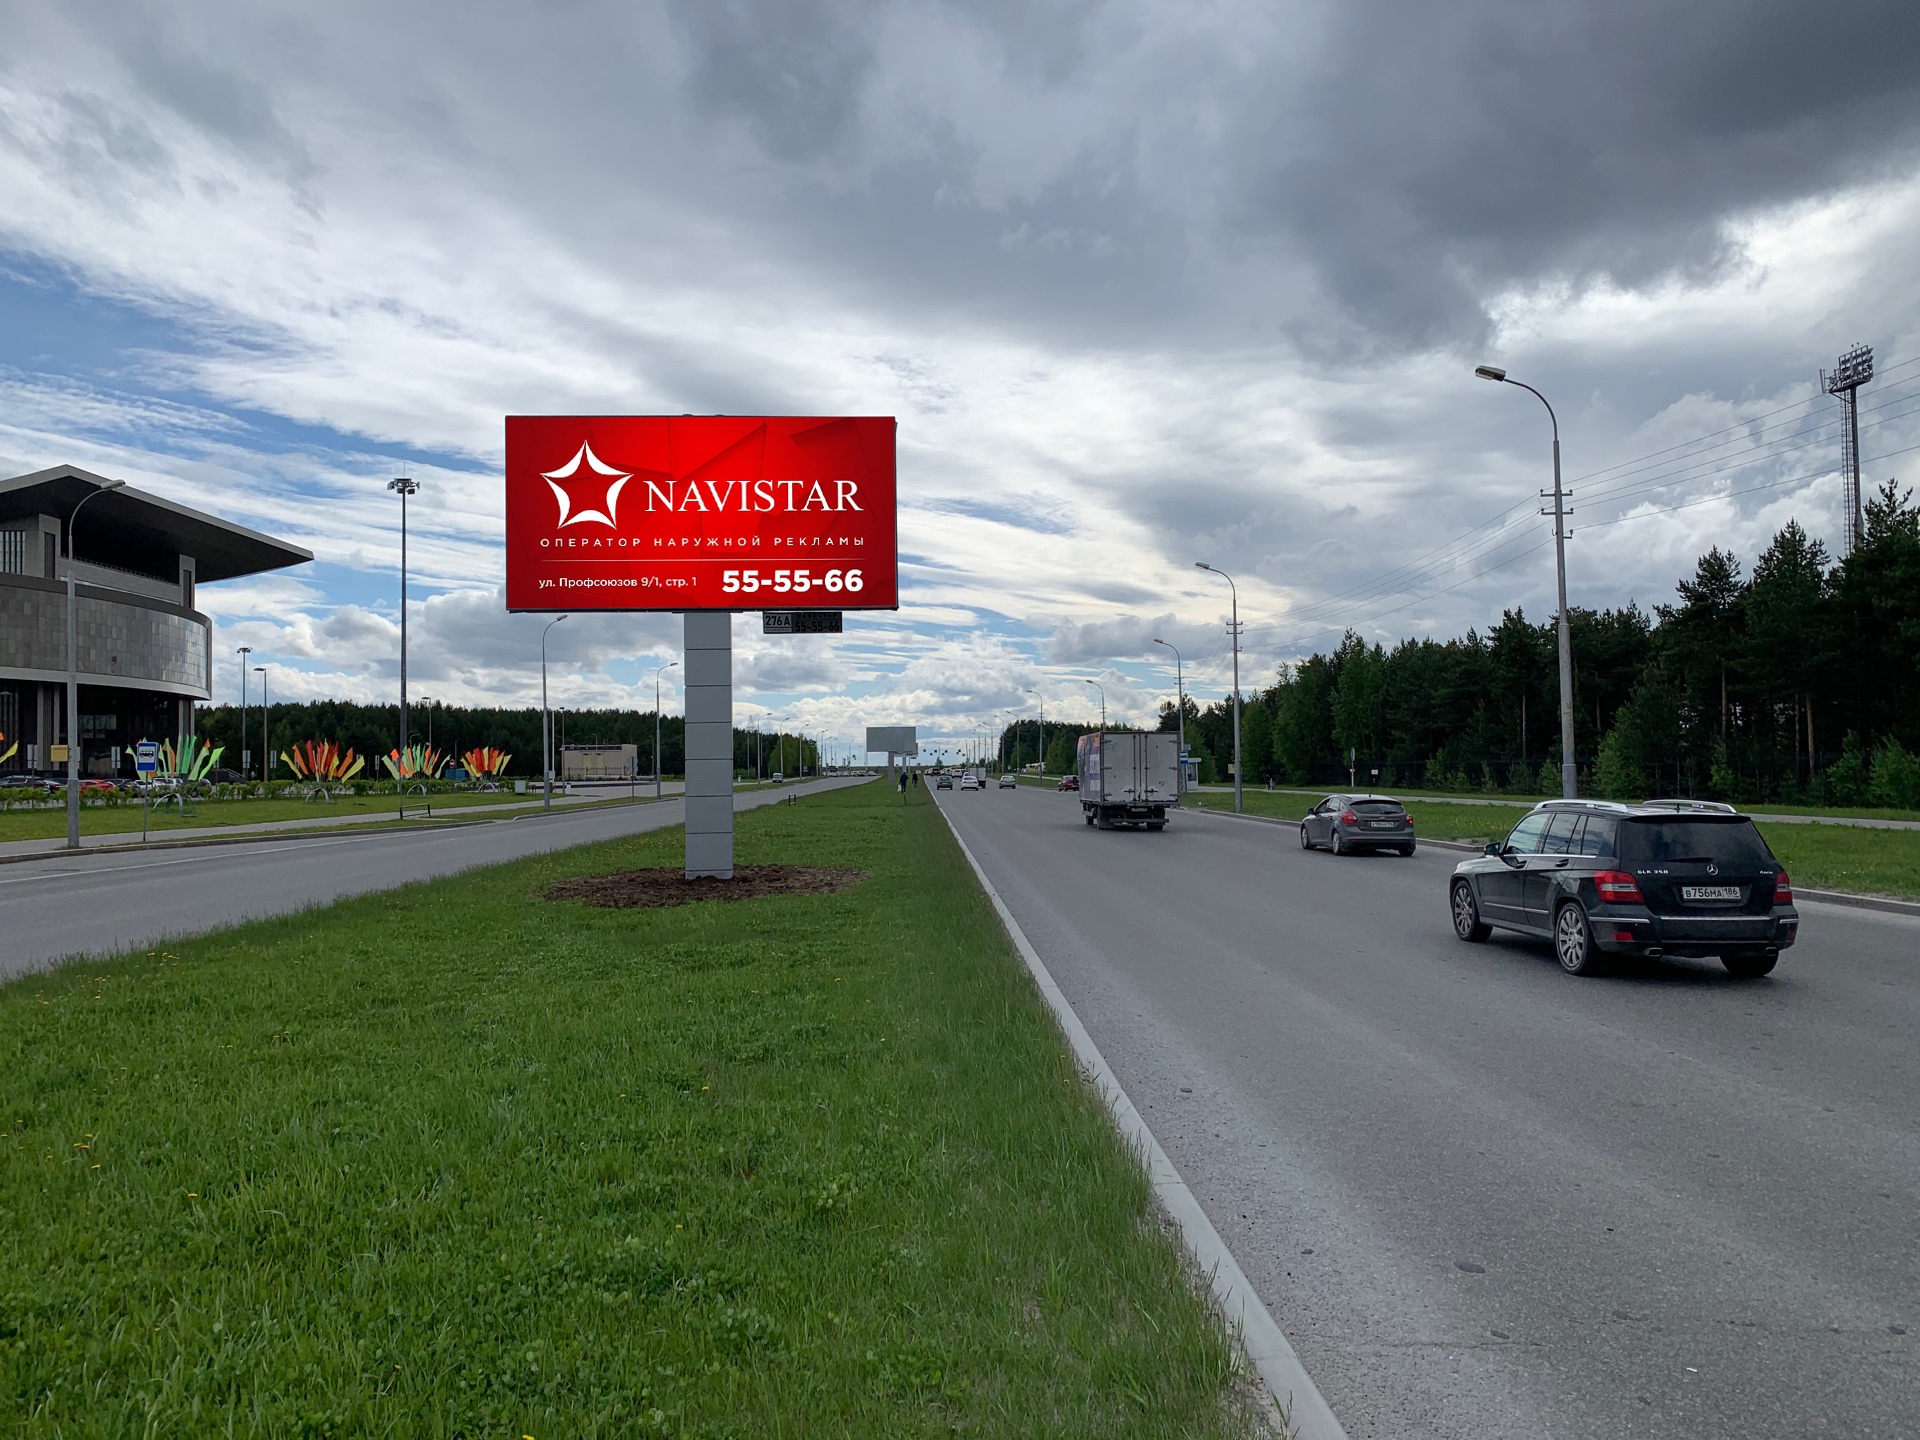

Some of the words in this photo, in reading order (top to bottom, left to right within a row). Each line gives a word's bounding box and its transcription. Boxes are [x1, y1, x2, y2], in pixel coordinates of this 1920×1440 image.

[643, 479, 864, 512] NAVISTAR
[540, 537, 641, 548] ОПЕРАТОР
[653, 534, 761, 547] НАРУЖНОЙ
[773, 536, 865, 547] РЕКЛАМЫ
[538, 579, 556, 588] ул.
[559, 577, 638, 589] Профсоюзов
[641, 576, 663, 588] 9/1,
[665, 577, 689, 588] стр.
[691, 576, 697, 586] 1
[721, 568, 864, 593] 55-55-66
[794, 621, 840, 632] 55-55-66
